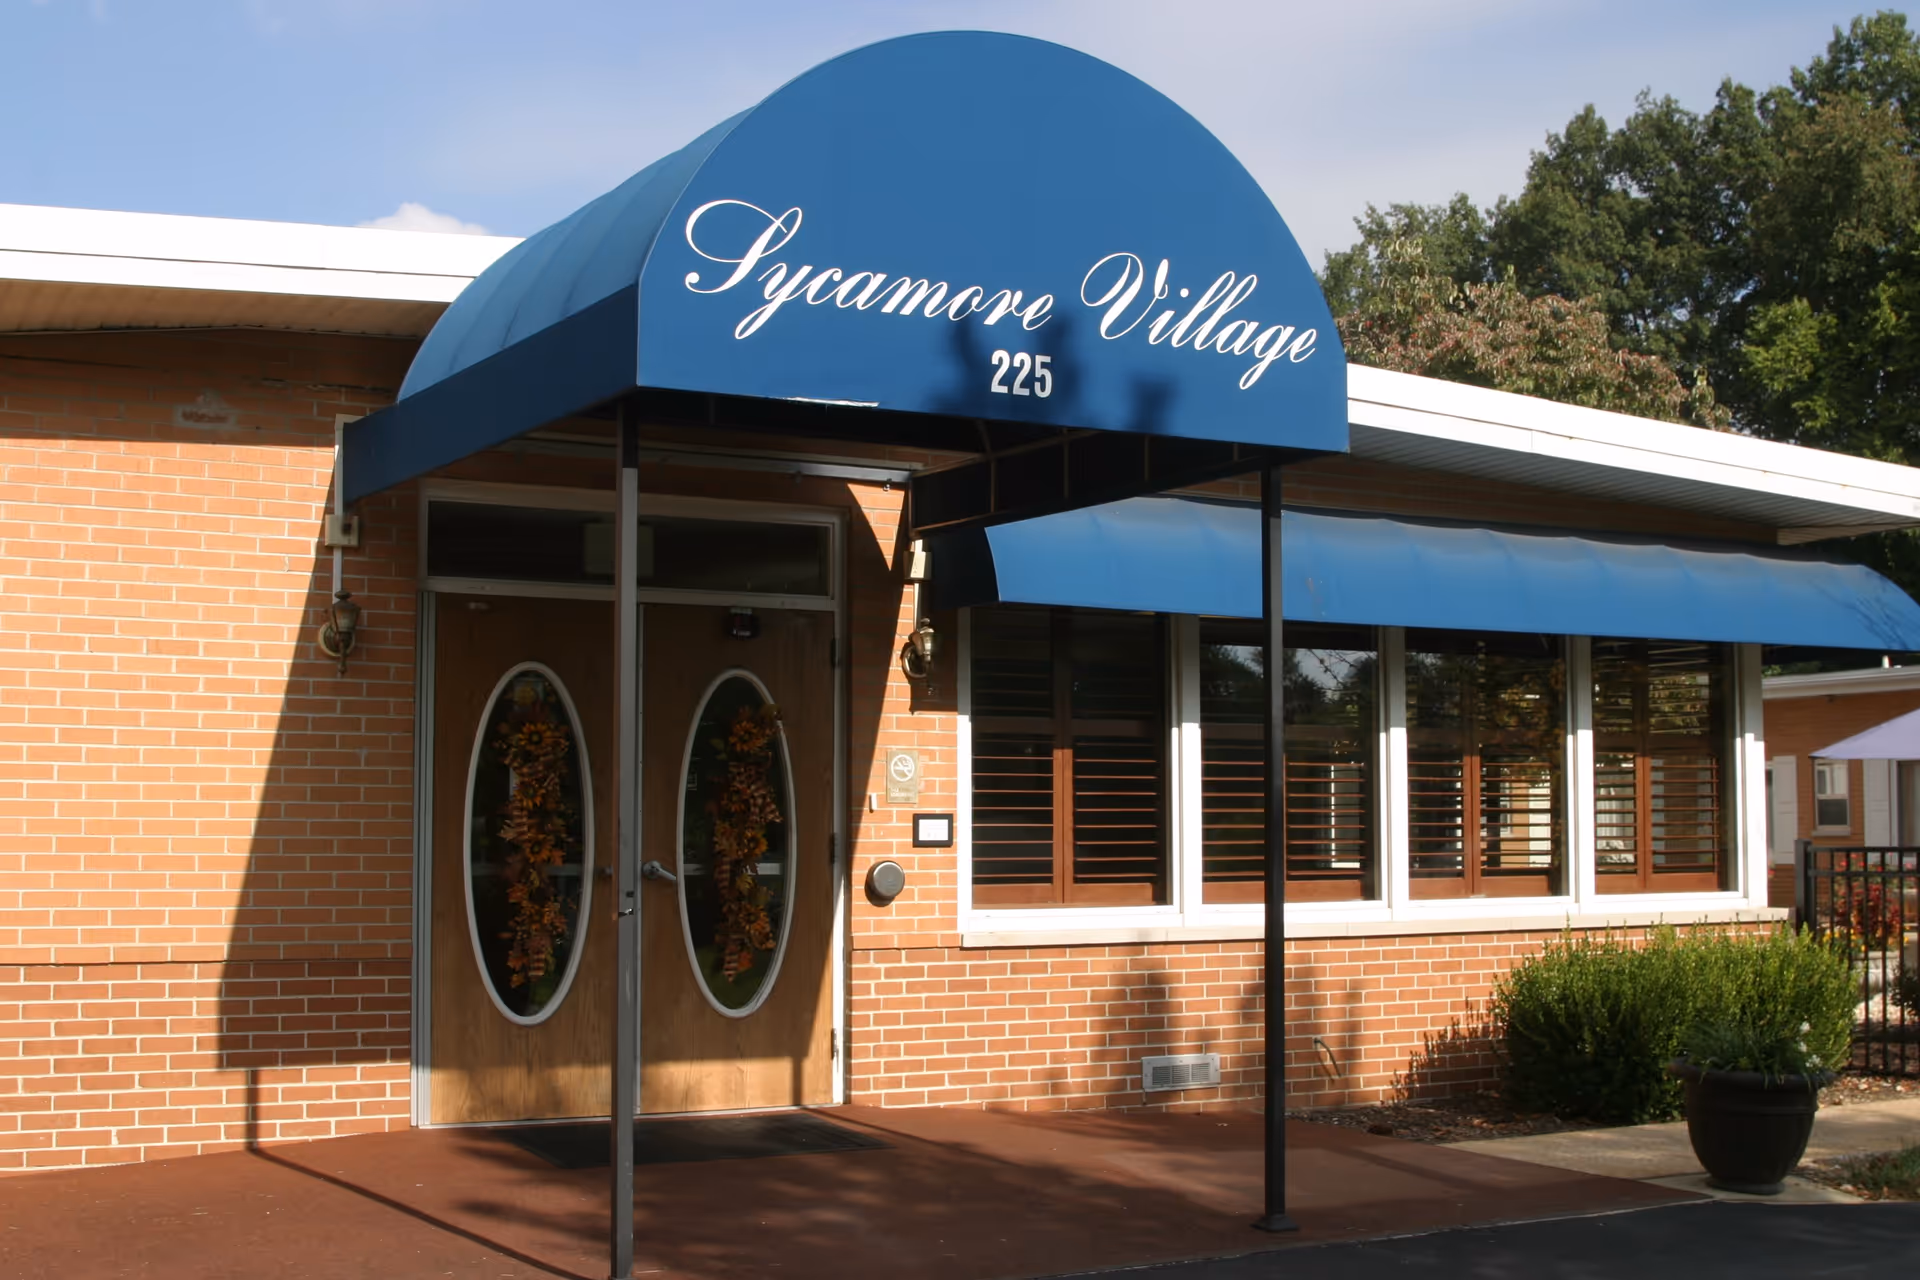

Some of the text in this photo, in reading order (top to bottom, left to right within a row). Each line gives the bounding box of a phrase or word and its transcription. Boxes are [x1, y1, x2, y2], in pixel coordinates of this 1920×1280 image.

[685, 200, 1317, 390] Sycamore Village
[990, 350, 1052, 398] 225
